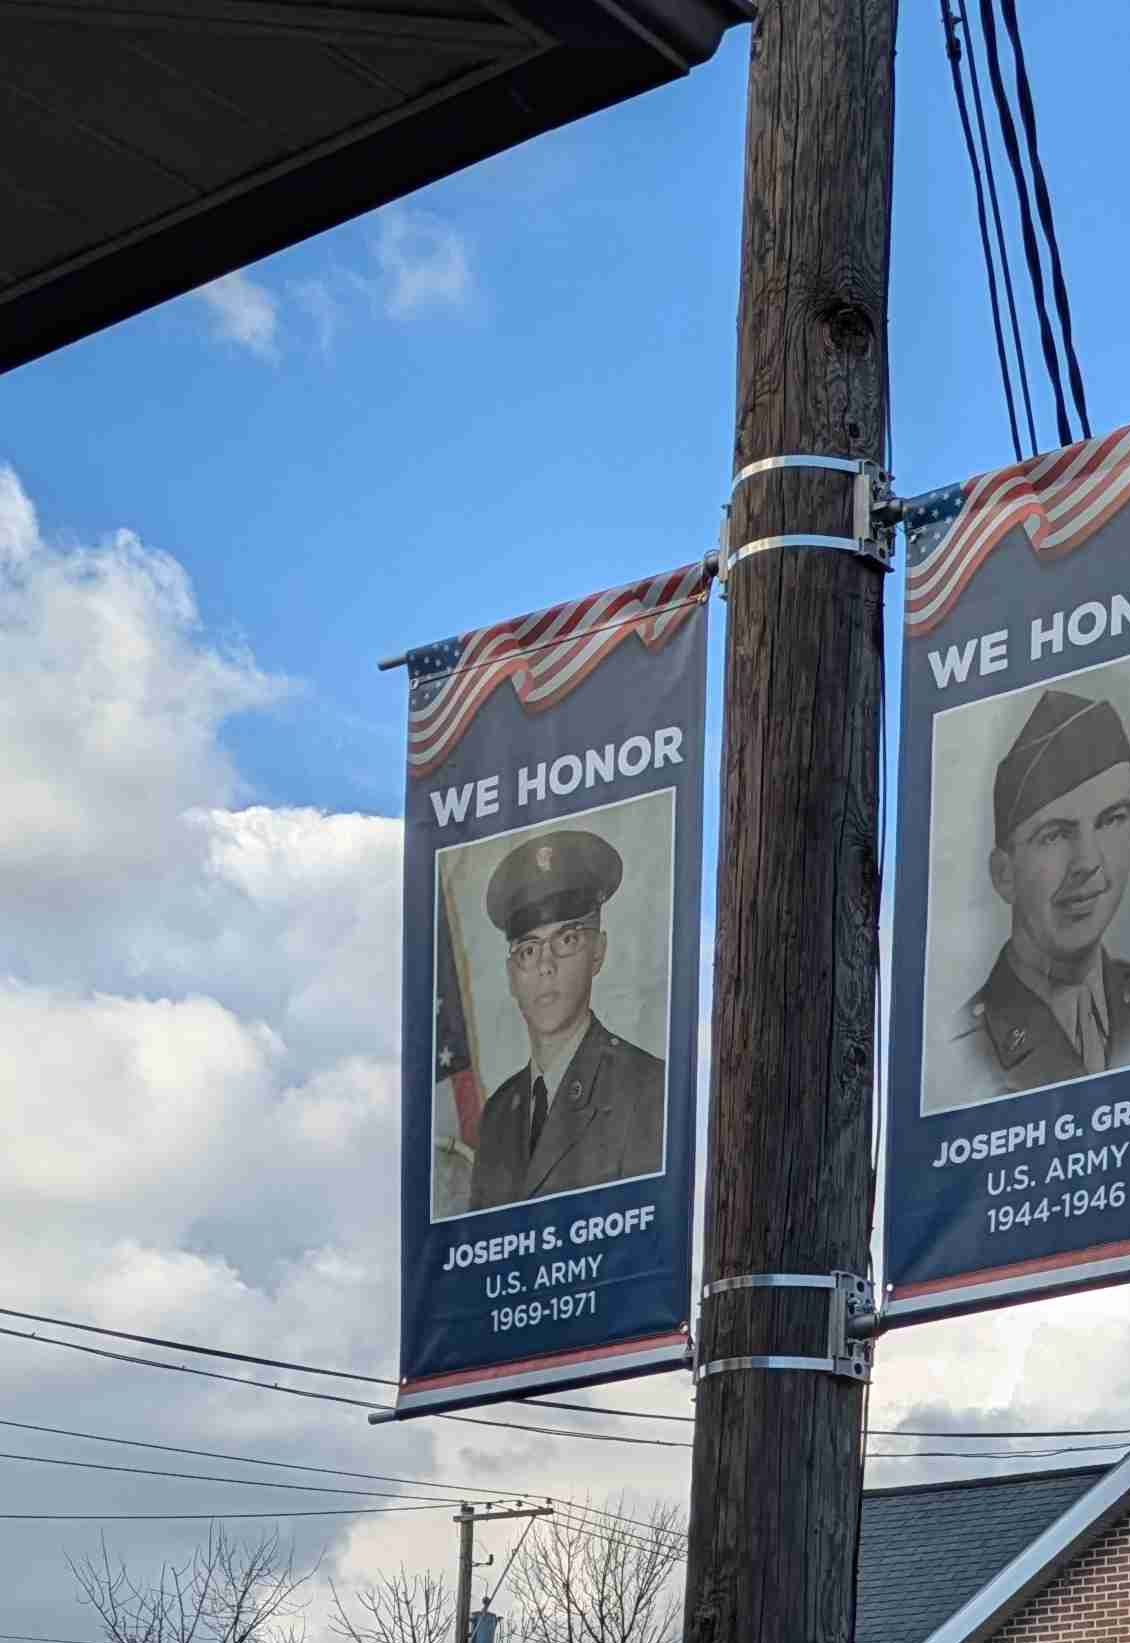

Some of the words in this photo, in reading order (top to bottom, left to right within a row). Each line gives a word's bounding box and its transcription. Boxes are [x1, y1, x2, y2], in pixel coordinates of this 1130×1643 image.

[927, 628, 1009, 690] WE
[430, 774, 500, 828] WE
[517, 726, 684, 807] HONOR
[932, 1119, 1046, 1168] JOSEPH
[1053, 1114, 1083, 1142] G.
[986, 1164, 1036, 1196] U.S.
[1044, 1141, 1130, 1185] ARMY
[986, 1181, 1126, 1233] 1944-1946
[442, 1229, 536, 1271] JOSEPH
[541, 1225, 563, 1250] S.
[569, 1205, 656, 1245] GROFF
[485, 1271, 527, 1299] U.S.
[534, 1253, 604, 1290] ARMY
[490, 1291, 597, 1333] 1969-1971
